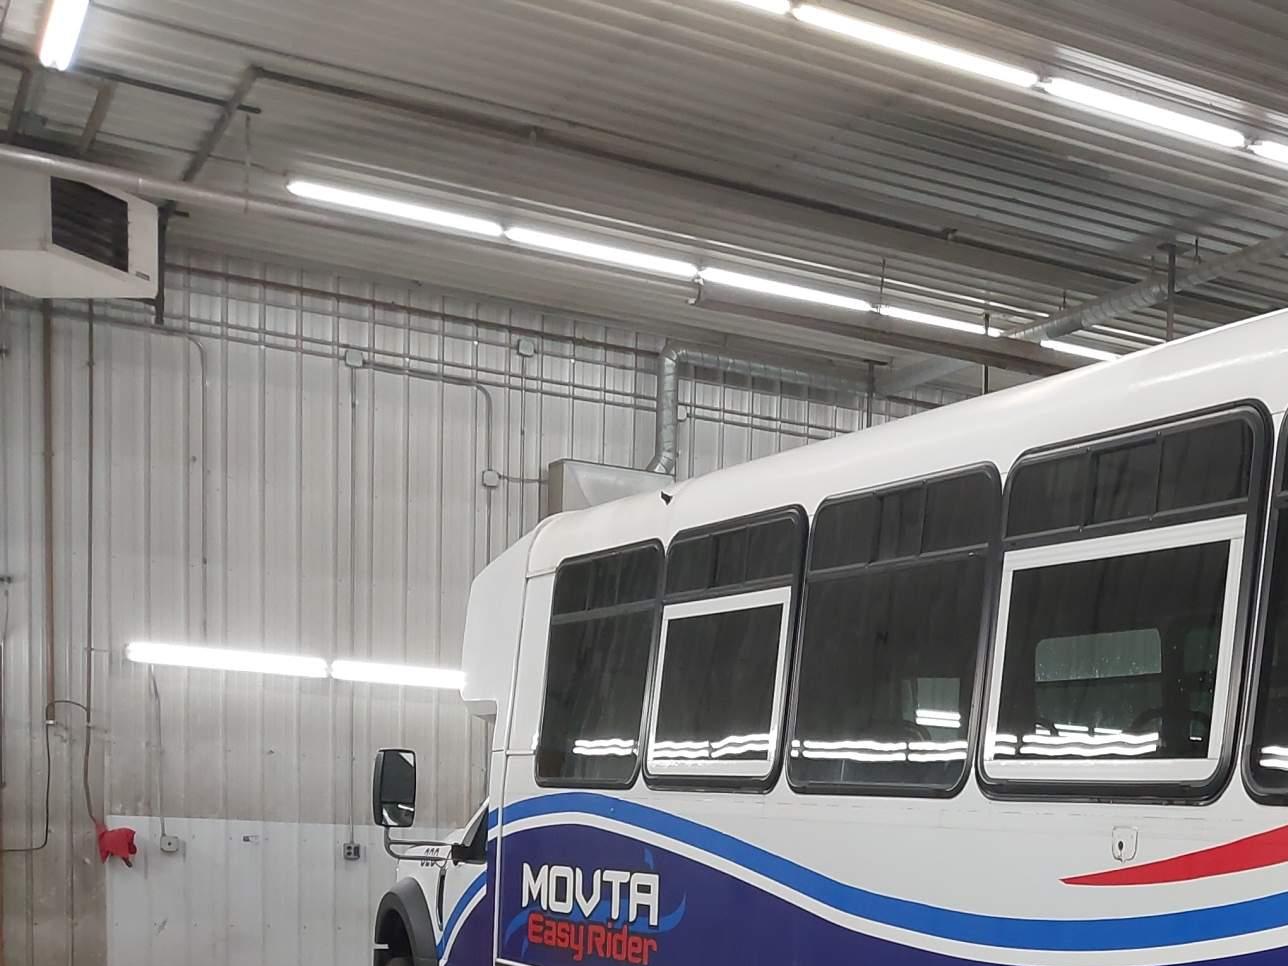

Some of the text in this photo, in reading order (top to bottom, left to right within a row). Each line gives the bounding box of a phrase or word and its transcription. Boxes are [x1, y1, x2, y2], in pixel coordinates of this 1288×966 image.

[522, 862, 660, 927] MOVTA
[527, 911, 658, 966] Easy Rider
